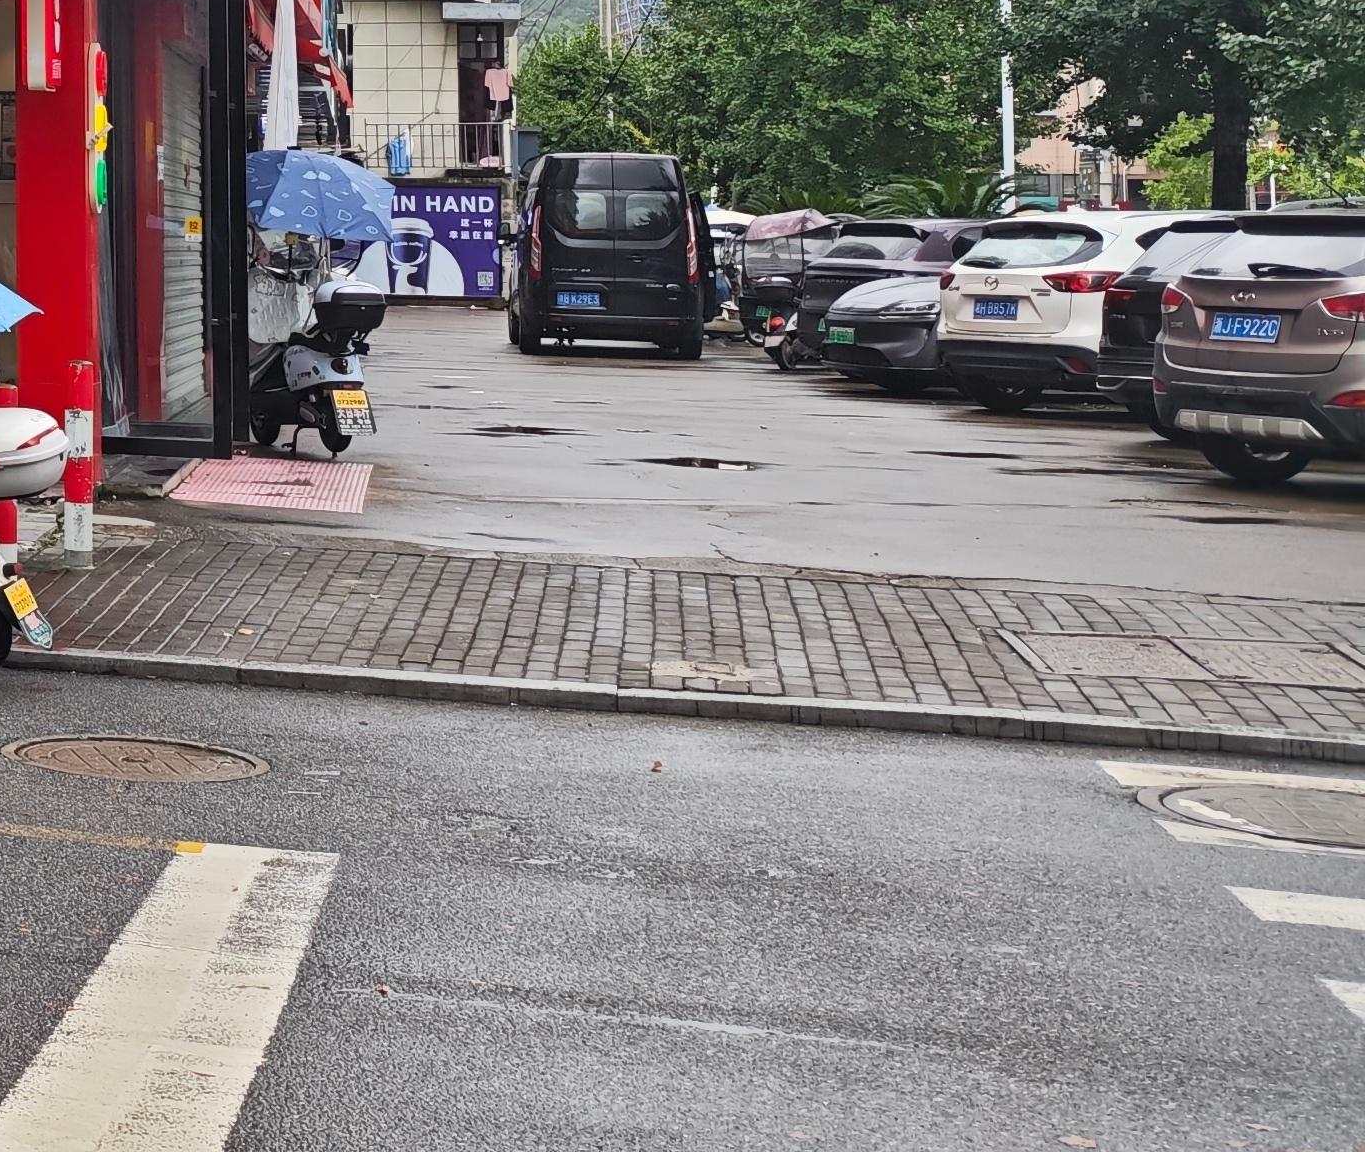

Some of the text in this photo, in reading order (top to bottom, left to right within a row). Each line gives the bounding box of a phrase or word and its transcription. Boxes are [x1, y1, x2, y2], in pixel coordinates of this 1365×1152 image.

[393, 195, 495, 213] IN HAND
[460, 218, 494, 228] 这一杯
